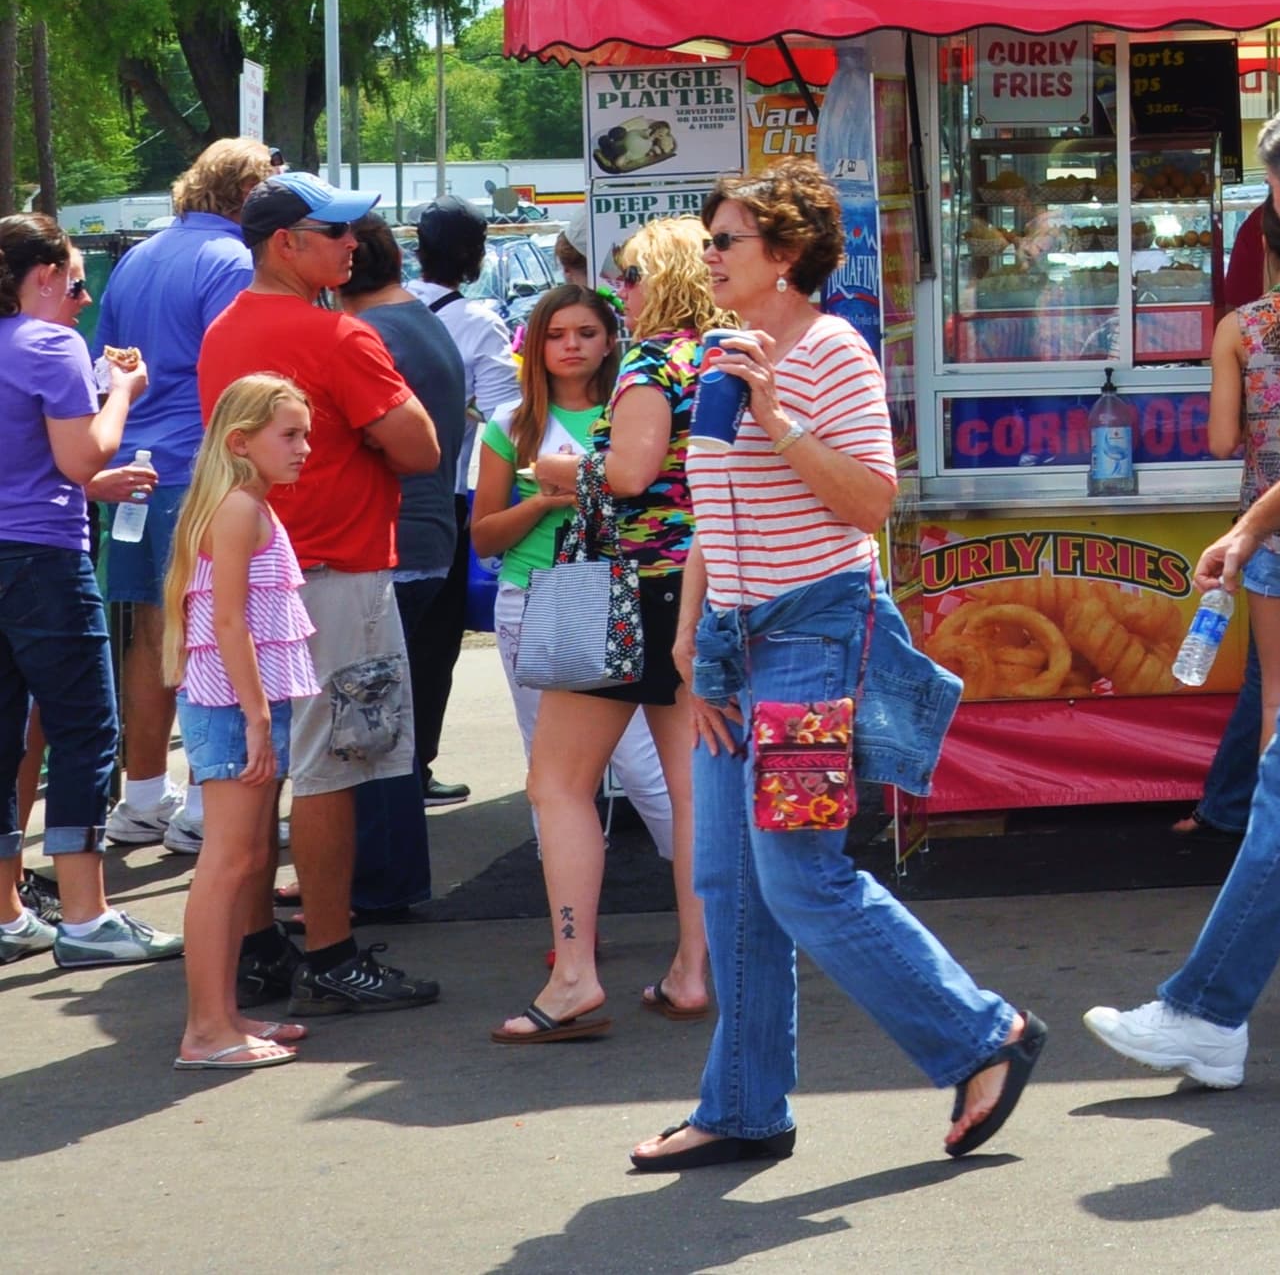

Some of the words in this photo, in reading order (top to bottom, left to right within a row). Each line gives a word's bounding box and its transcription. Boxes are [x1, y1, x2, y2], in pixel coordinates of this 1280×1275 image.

[987, 39, 1078, 66] CURLY
[1100, 46, 1185, 68] Sorts
[608, 69, 722, 91] VEGGIE
[993, 71, 1073, 98] FRIES
[597, 87, 734, 109] PLATTER
[595, 195, 658, 213] DEEP
[1057, 531, 1193, 596] FRIES
